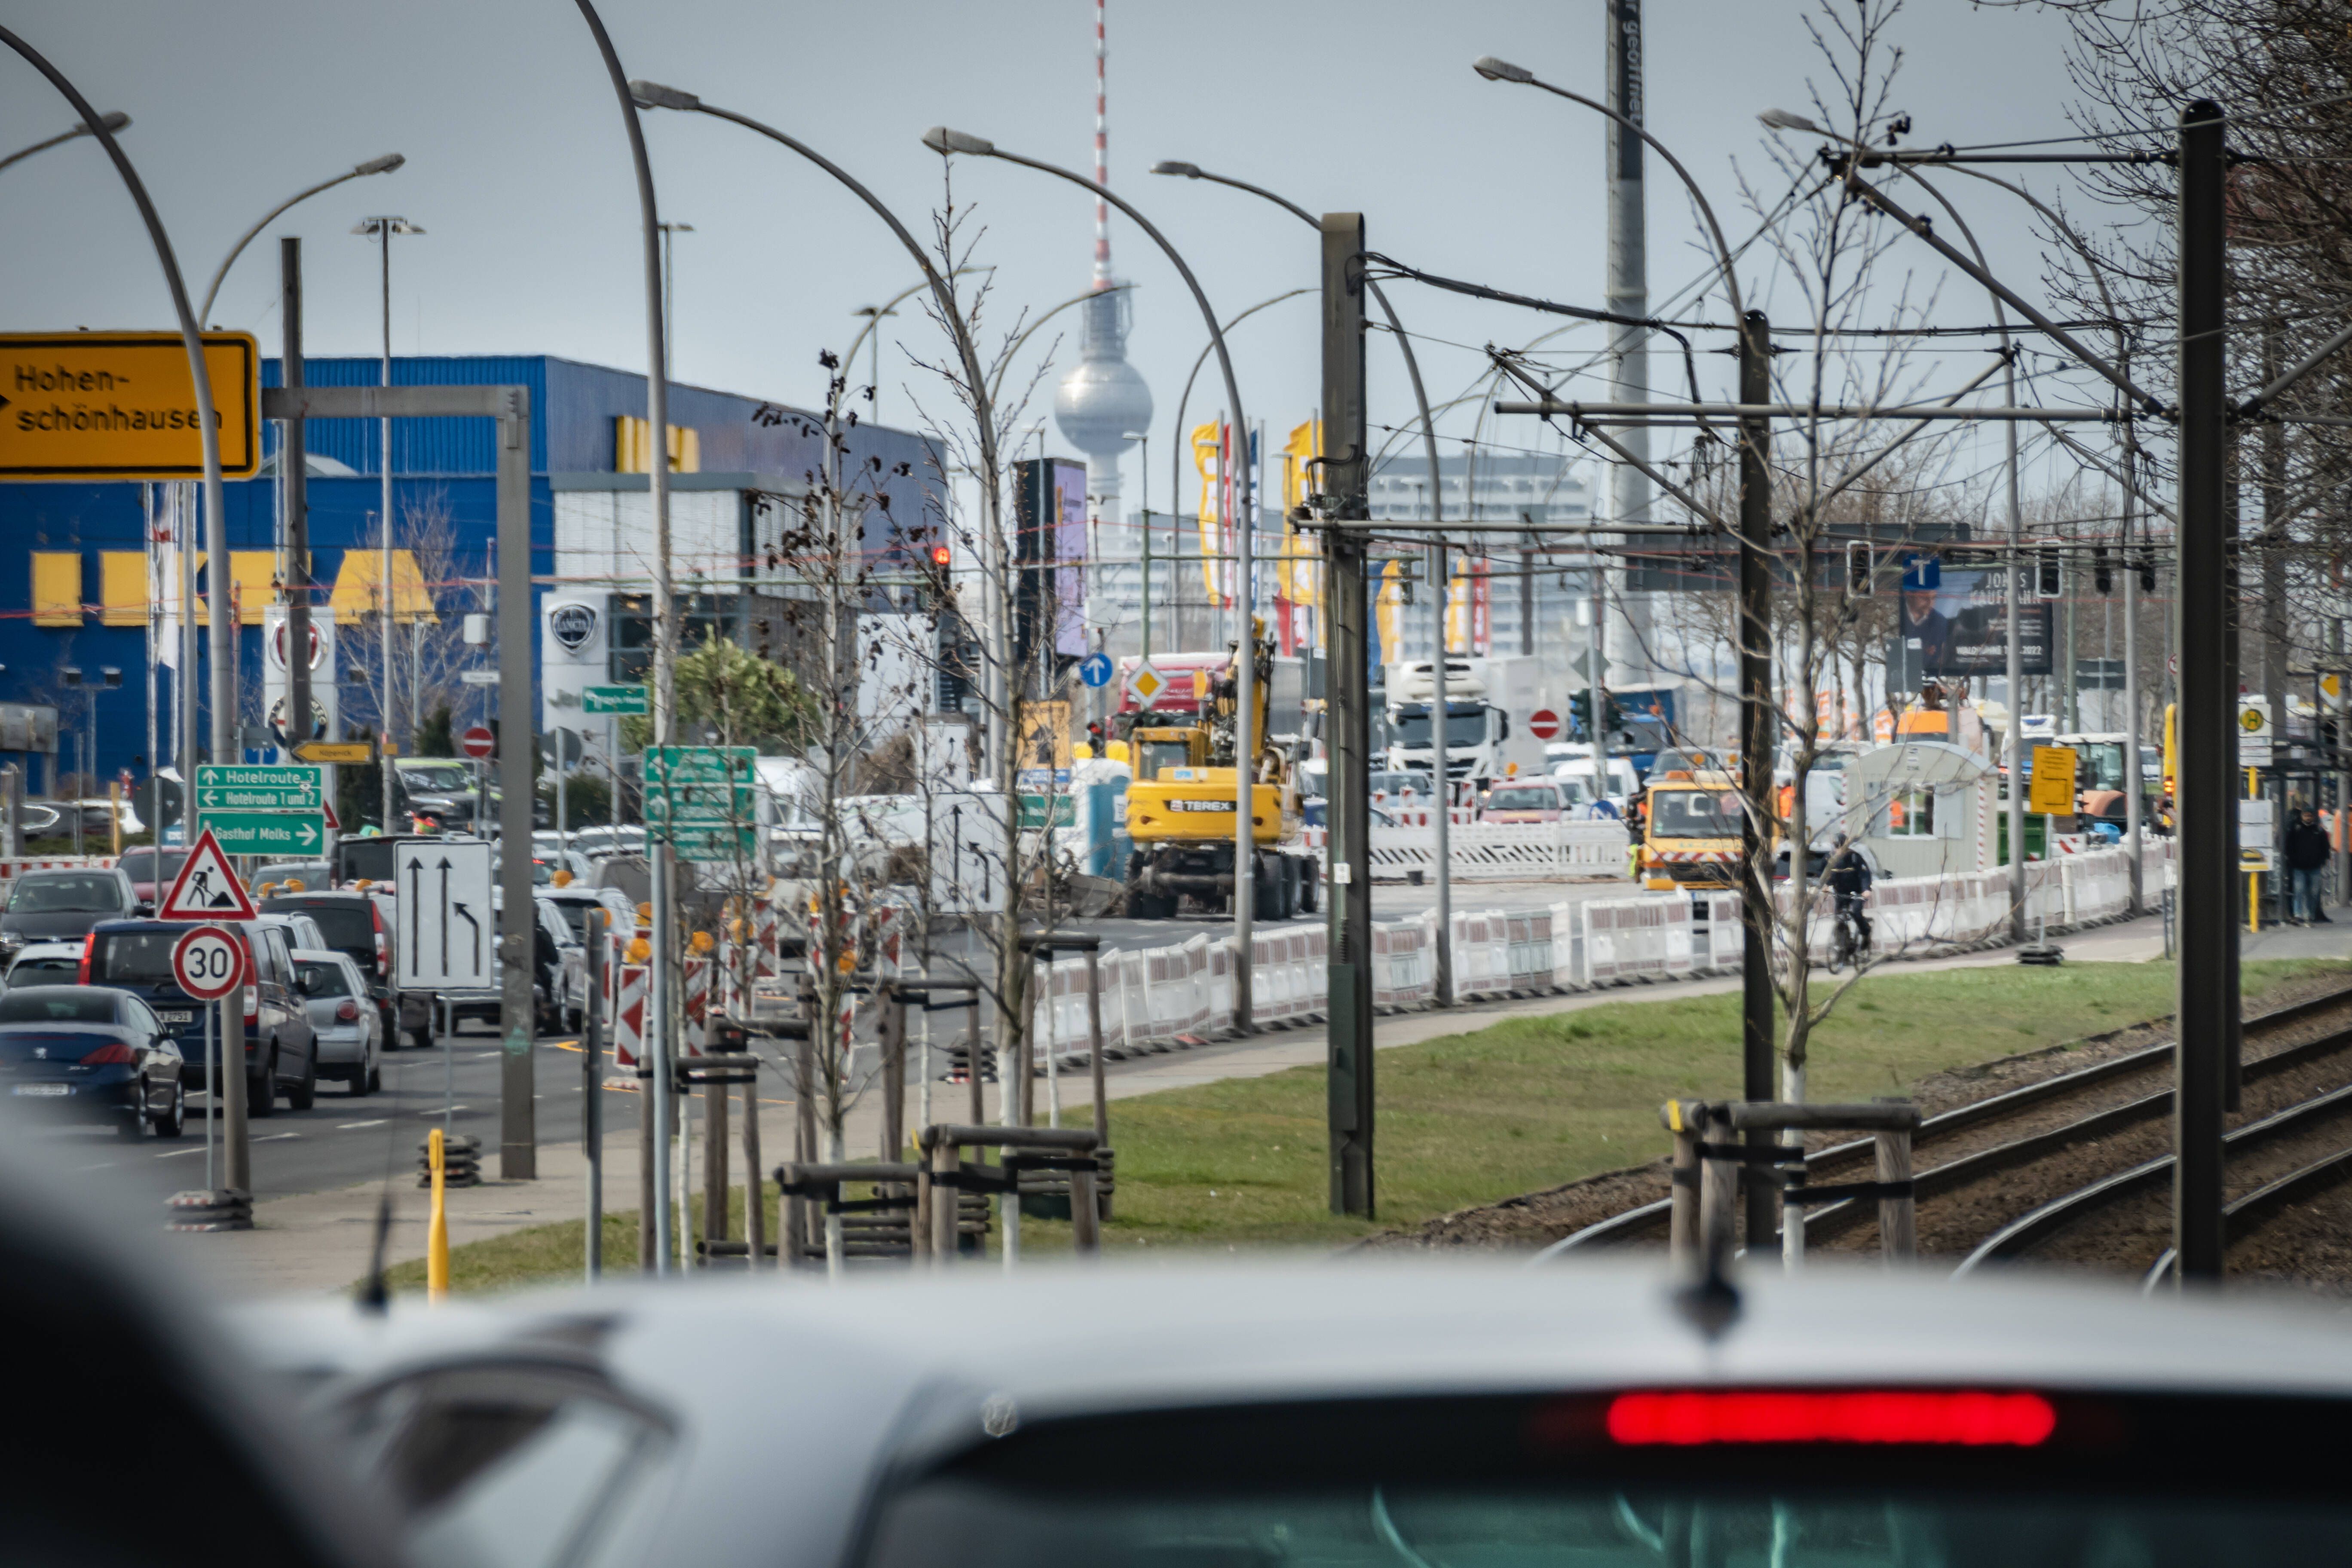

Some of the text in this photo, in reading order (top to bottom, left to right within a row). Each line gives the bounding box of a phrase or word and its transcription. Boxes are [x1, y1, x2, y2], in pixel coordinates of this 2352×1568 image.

[15, 364, 130, 392] Hohen-
[16, 402, 222, 431] schönhausen
[1985, 572, 2027, 588] JONS
[226, 770, 315, 784] Hotelroute 3
[226, 792, 315, 805] Hotelroute 1 und 2
[1184, 801, 1230, 811] TEREX
[215, 827, 256, 840] Gasthof
[188, 947, 228, 979] 30
